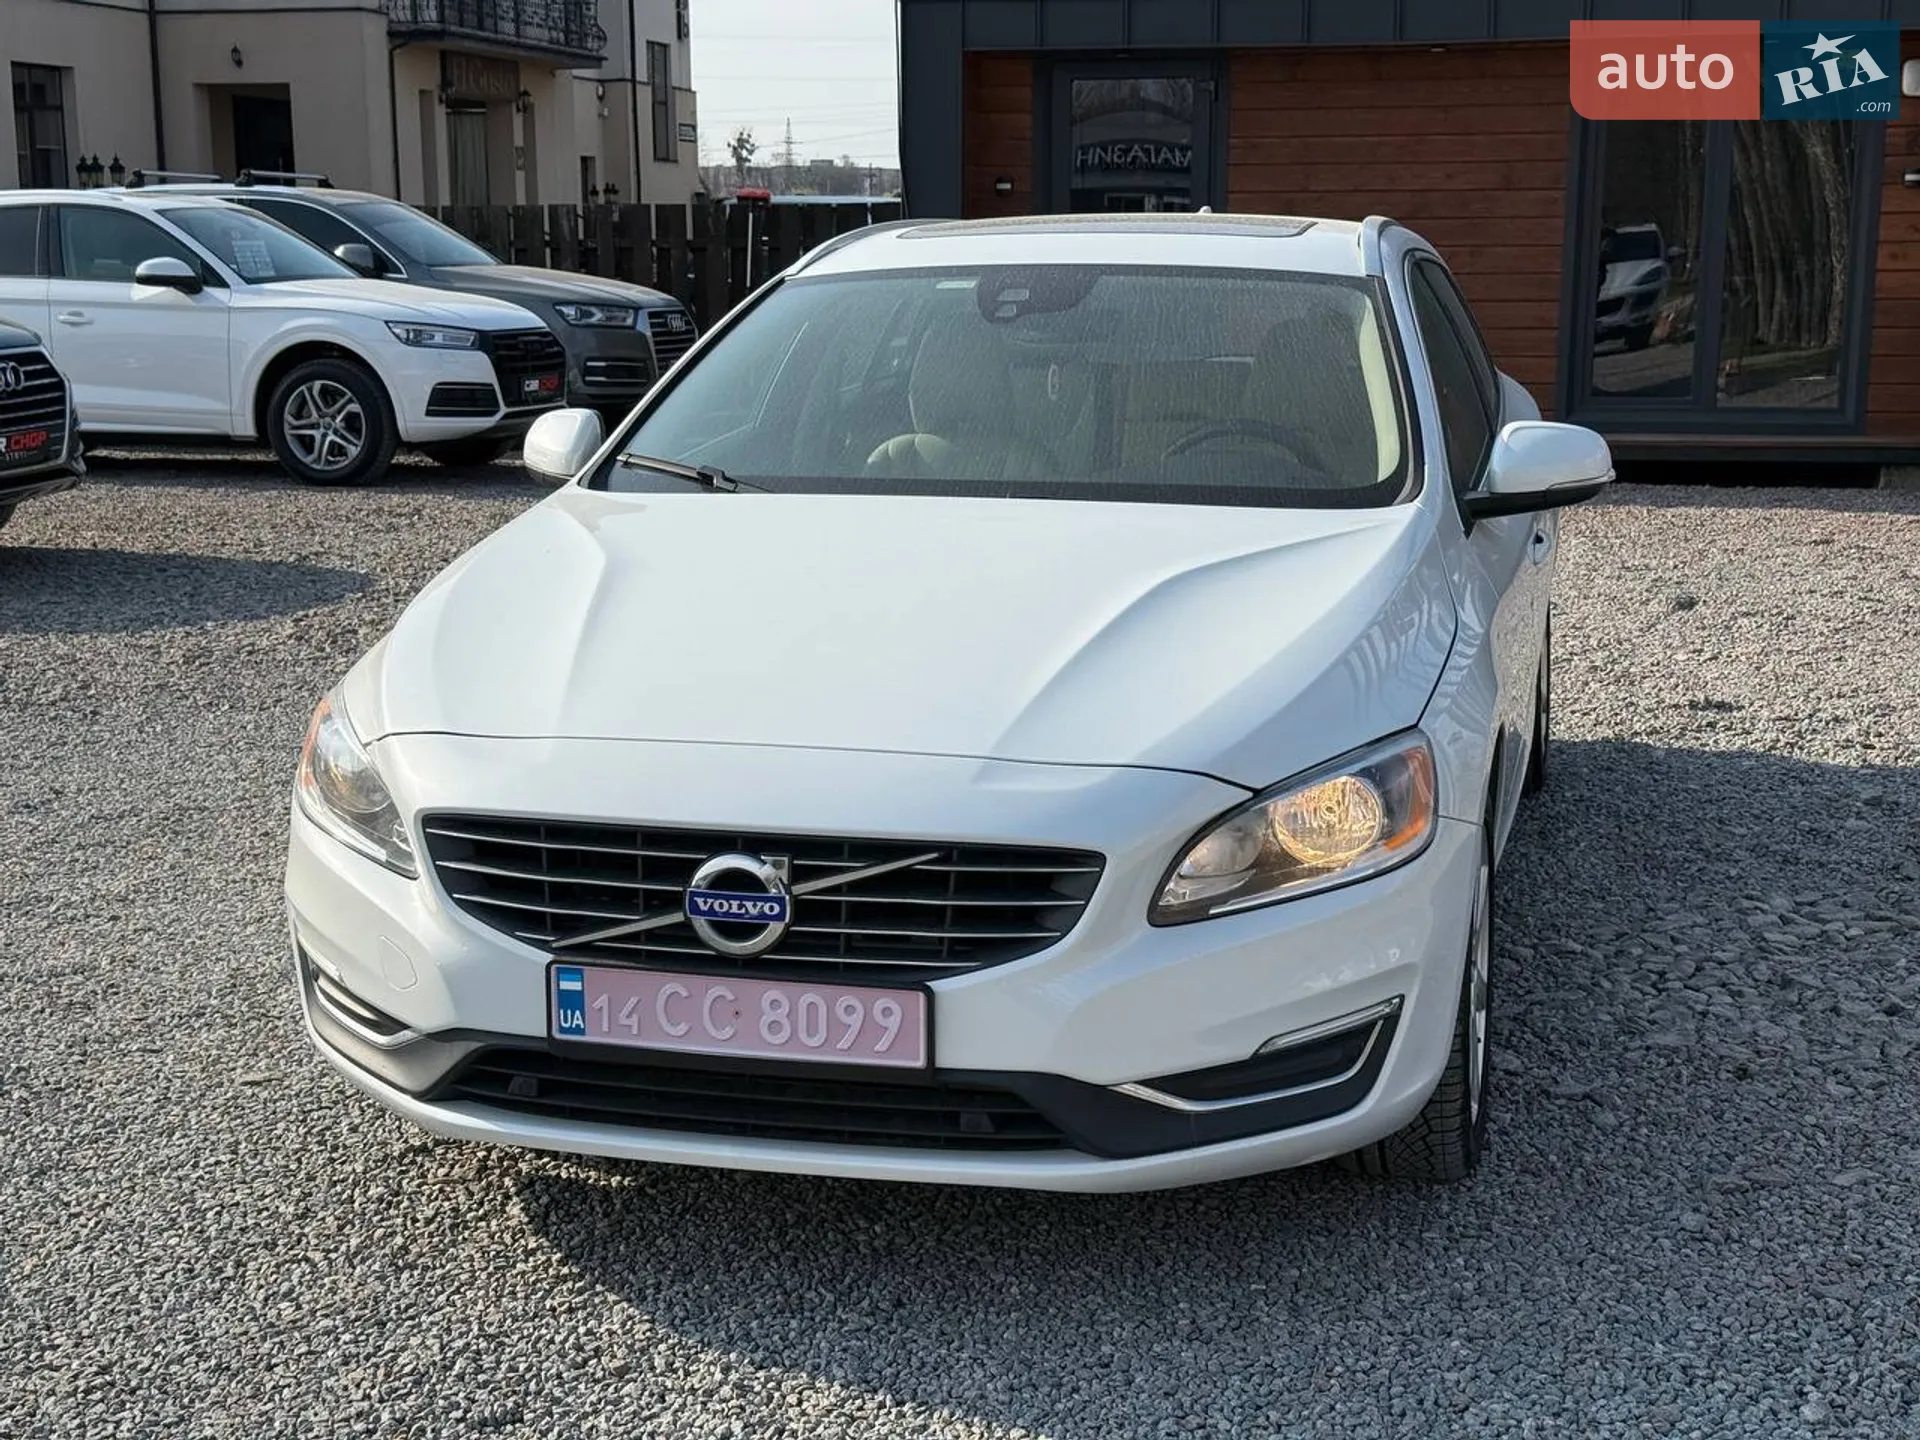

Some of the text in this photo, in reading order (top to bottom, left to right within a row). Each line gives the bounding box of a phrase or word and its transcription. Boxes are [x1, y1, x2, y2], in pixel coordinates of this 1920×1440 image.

[693, 896, 781, 916] VOLVO
[559, 1007, 585, 1030] UA
[758, 989, 904, 1054] 8099
